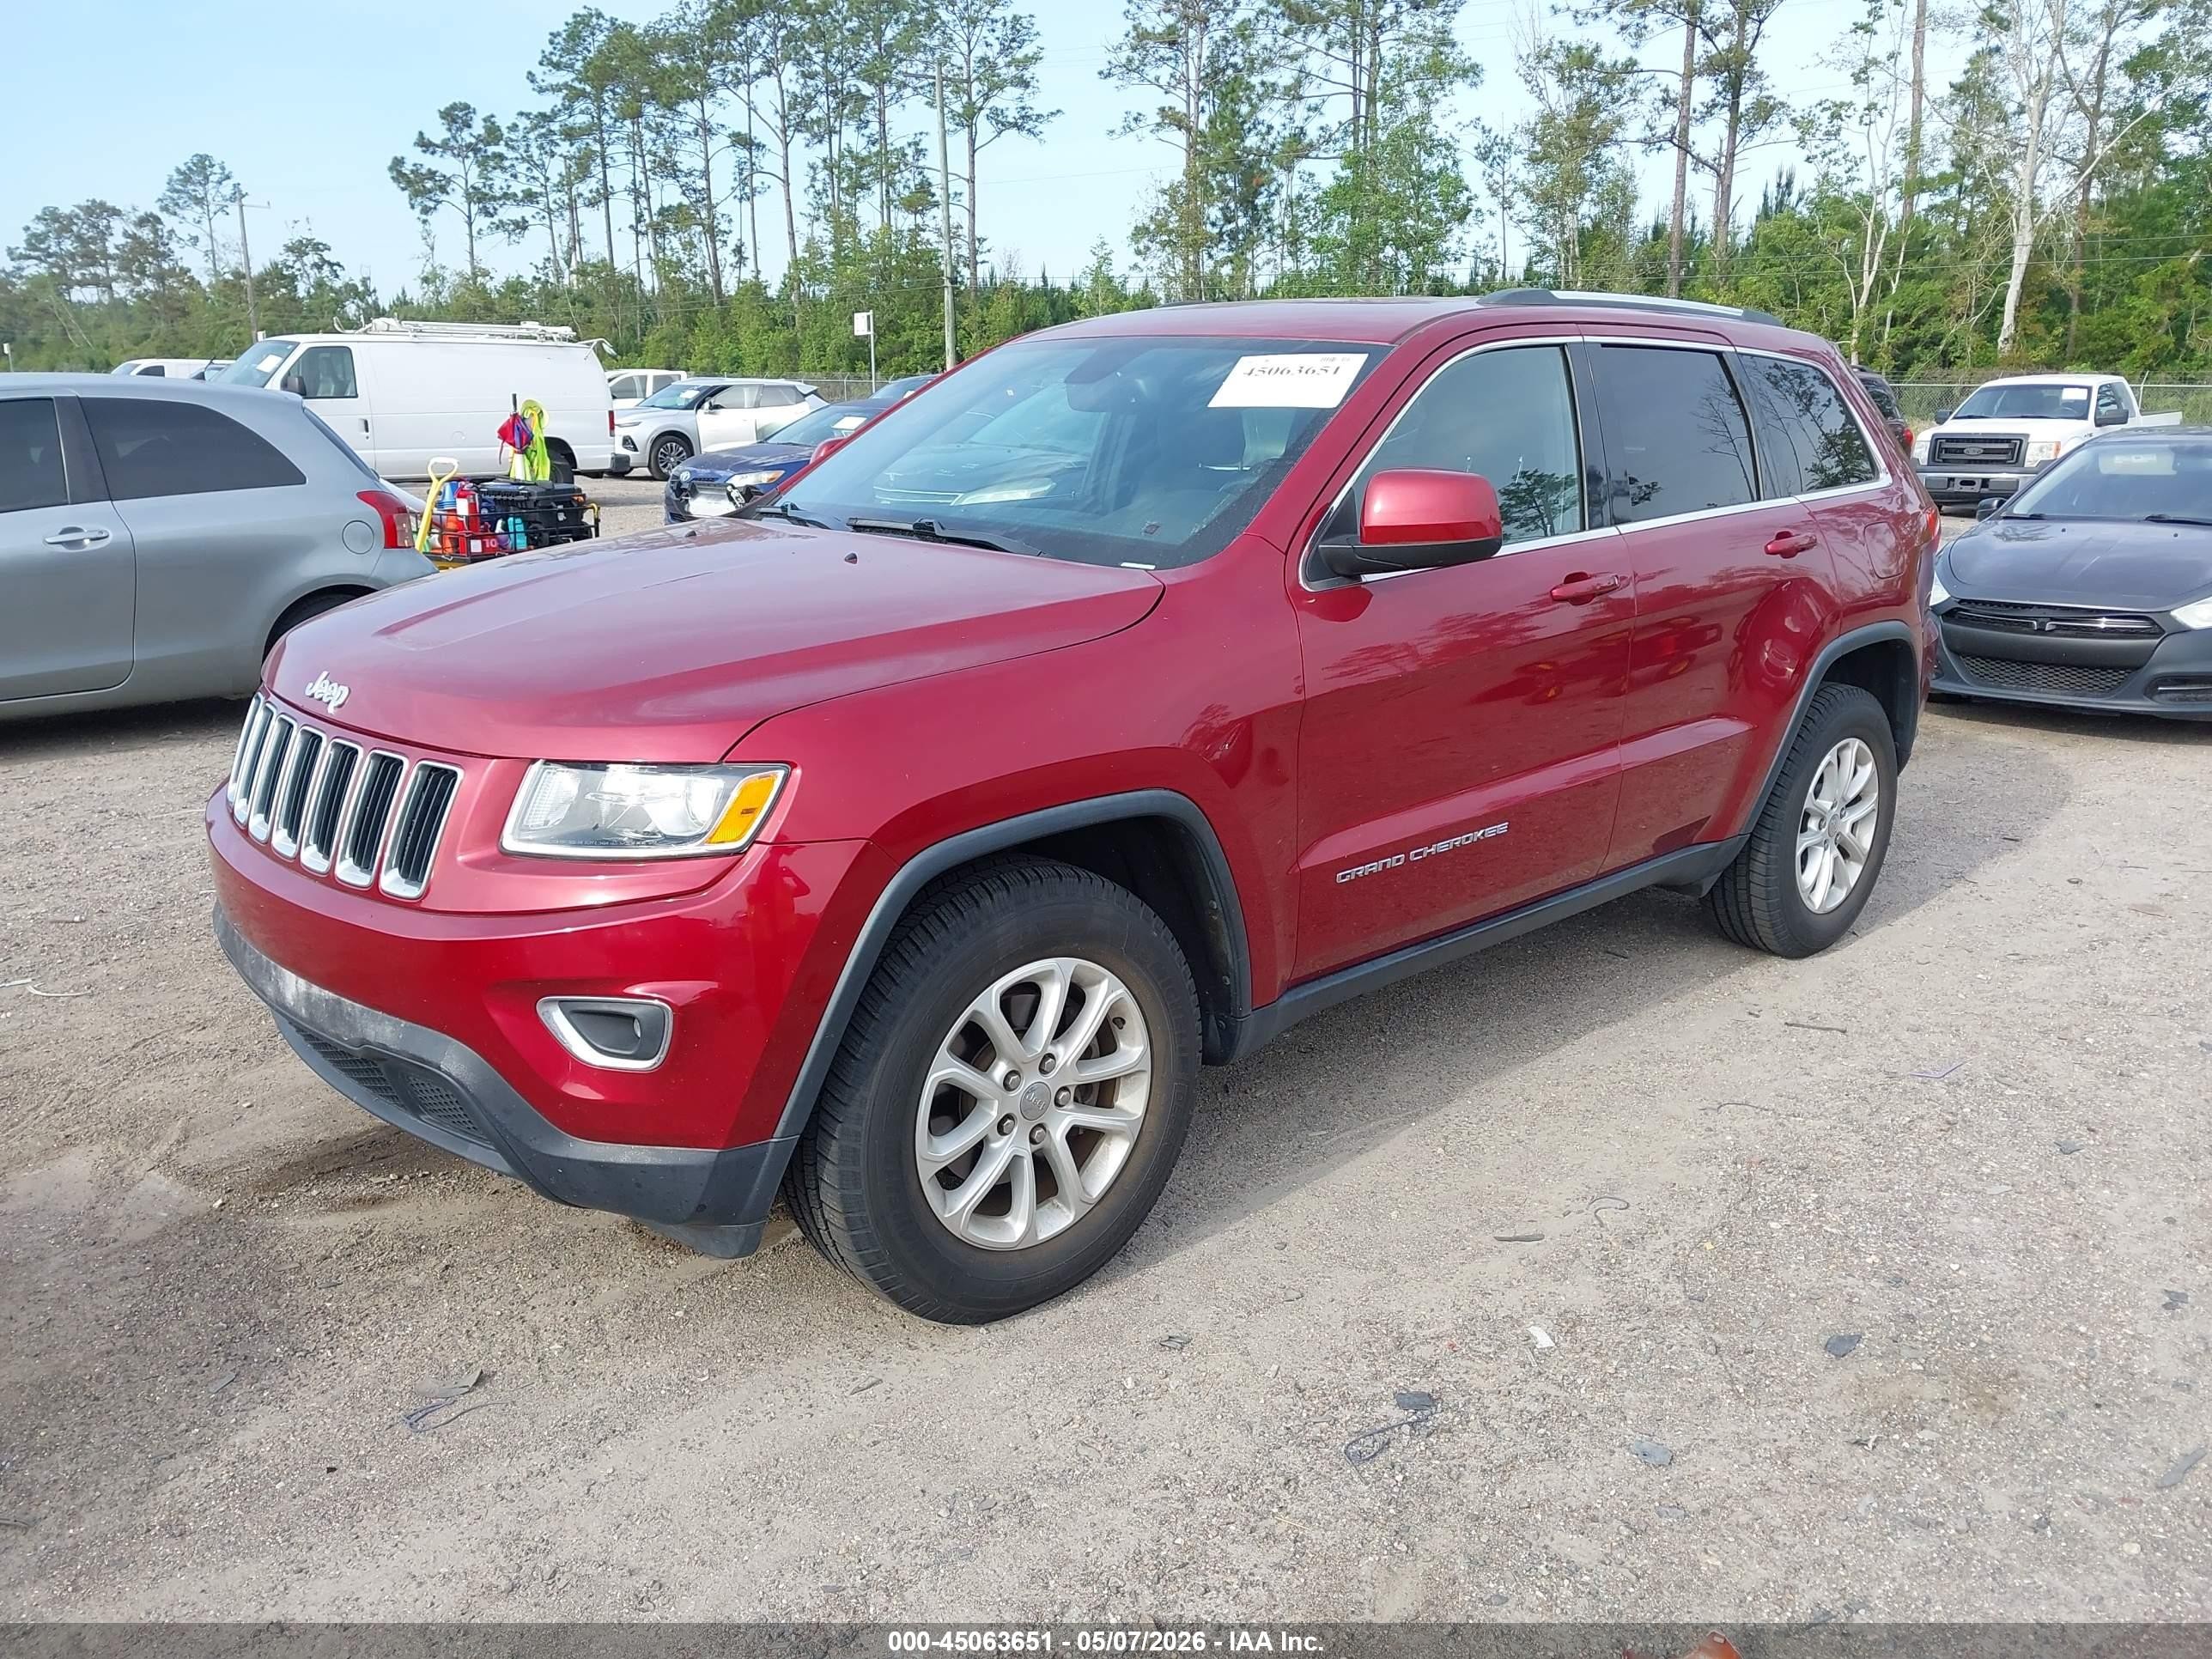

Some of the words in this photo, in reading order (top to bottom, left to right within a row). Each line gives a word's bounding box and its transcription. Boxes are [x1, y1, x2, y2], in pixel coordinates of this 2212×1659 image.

[1243, 366, 1340, 377] 45063651
[305, 671, 351, 715] Jeep
[1336, 854, 1406, 884] GRAND
[1409, 822, 1510, 862] CHEROKEE
